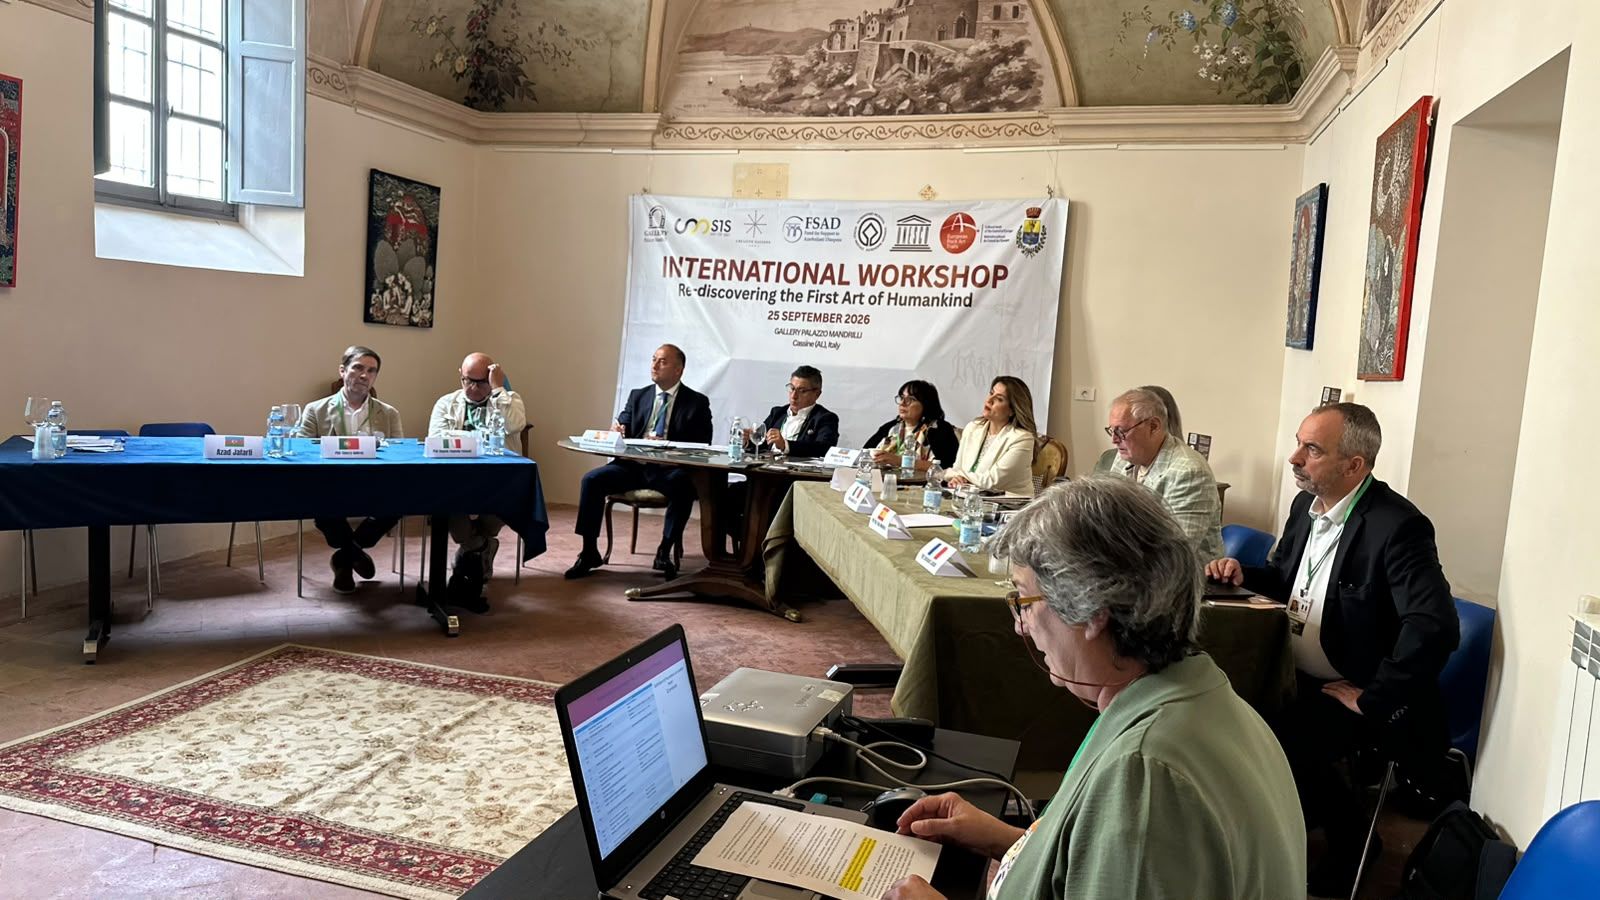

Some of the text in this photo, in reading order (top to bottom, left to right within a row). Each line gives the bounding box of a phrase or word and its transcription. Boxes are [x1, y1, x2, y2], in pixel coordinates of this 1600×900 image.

[805, 216, 841, 230] FSAD
[896, 226, 929, 244] UNESCO
[662, 255, 1009, 289] INTERNATIONAL WORKSHOP
[678, 283, 973, 308] Re-discovering the First Art of Humankind
[767, 310, 871, 325] 25 SEPTEMBER 2026
[774, 327, 863, 339] GALLERY PALAZZO MANDRILLI
[792, 339, 814, 348] Cassine
[828, 340, 840, 350] Italy
[216, 448, 231, 456] Azad
